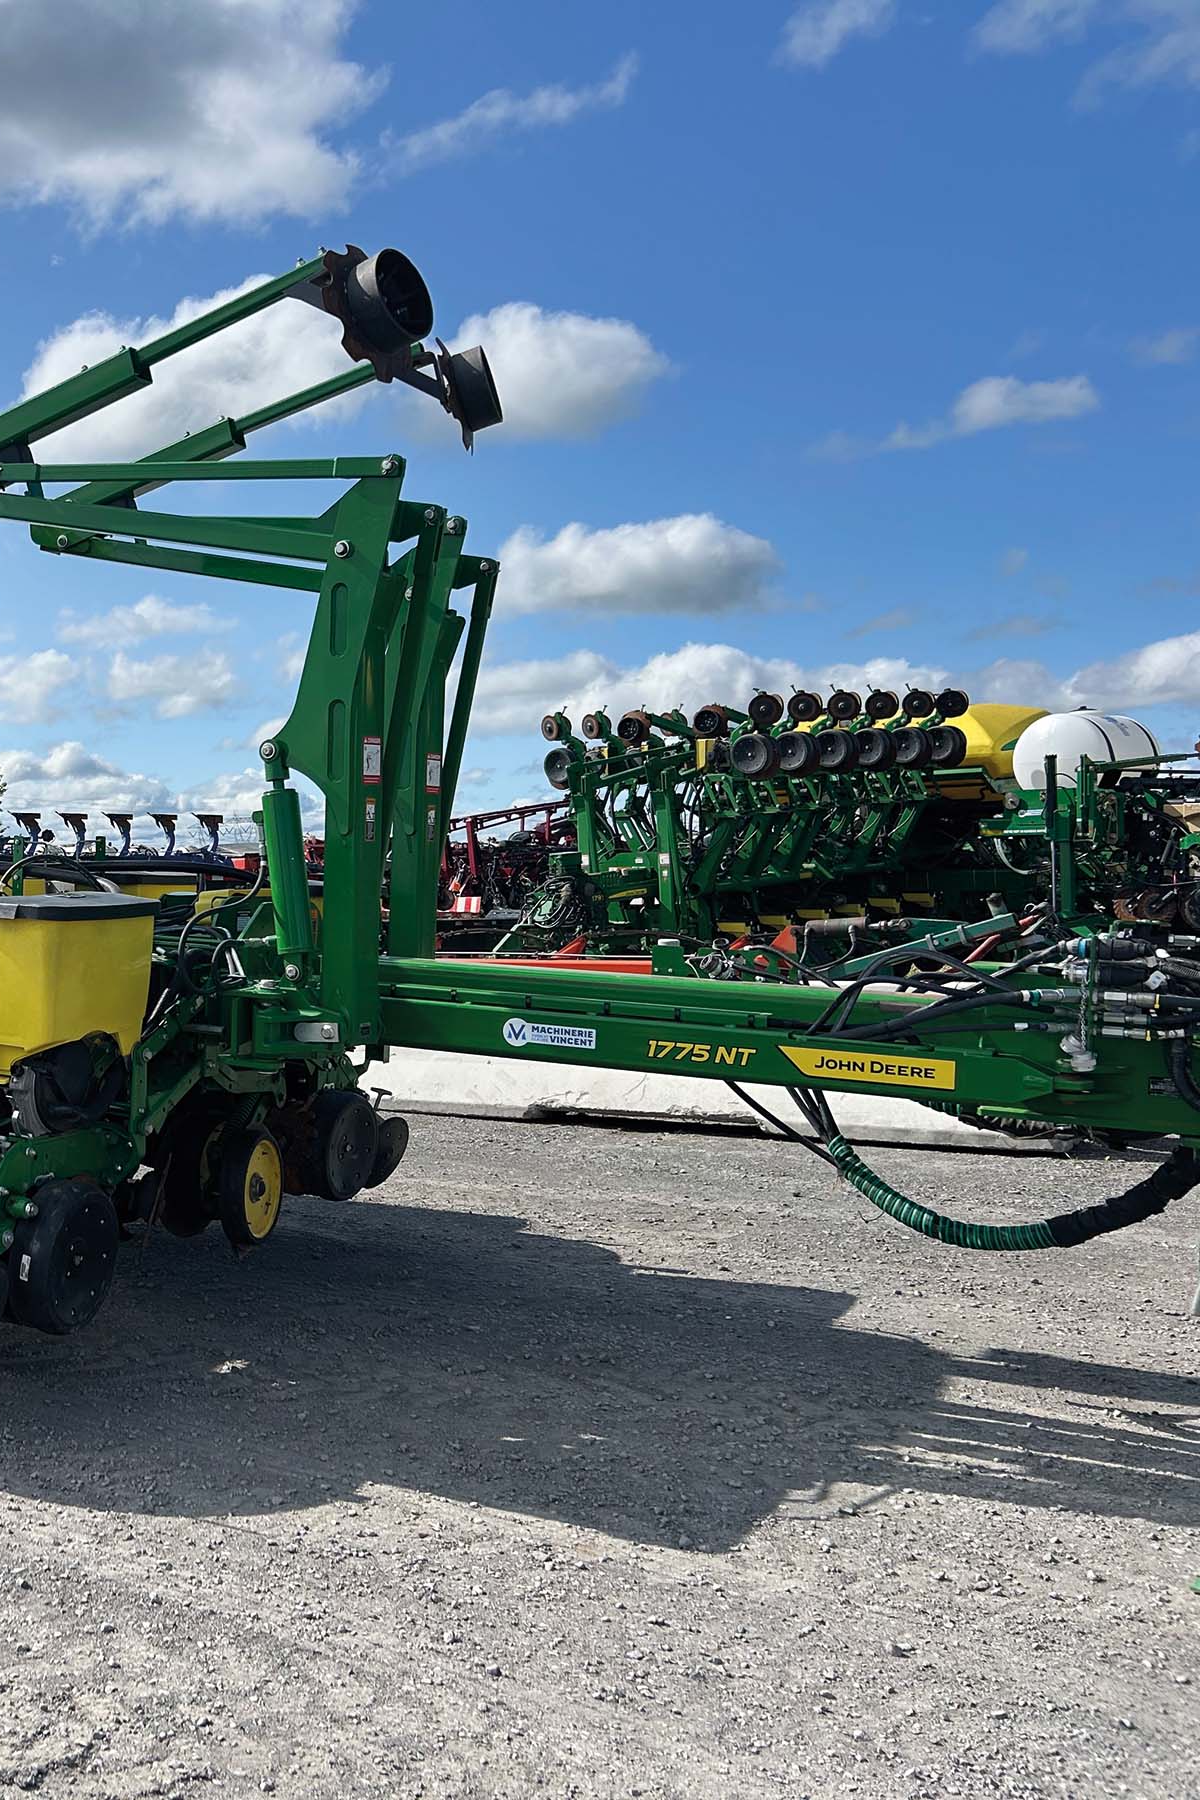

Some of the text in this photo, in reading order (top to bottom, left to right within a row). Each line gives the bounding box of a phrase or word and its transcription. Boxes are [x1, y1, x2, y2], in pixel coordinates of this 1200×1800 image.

[531, 1025, 594, 1038] MACHINERIE
[549, 1036, 593, 1046] VINCENT
[647, 1040, 757, 1066] 1775 NT
[814, 1056, 936, 1079] JOHN DEERE
